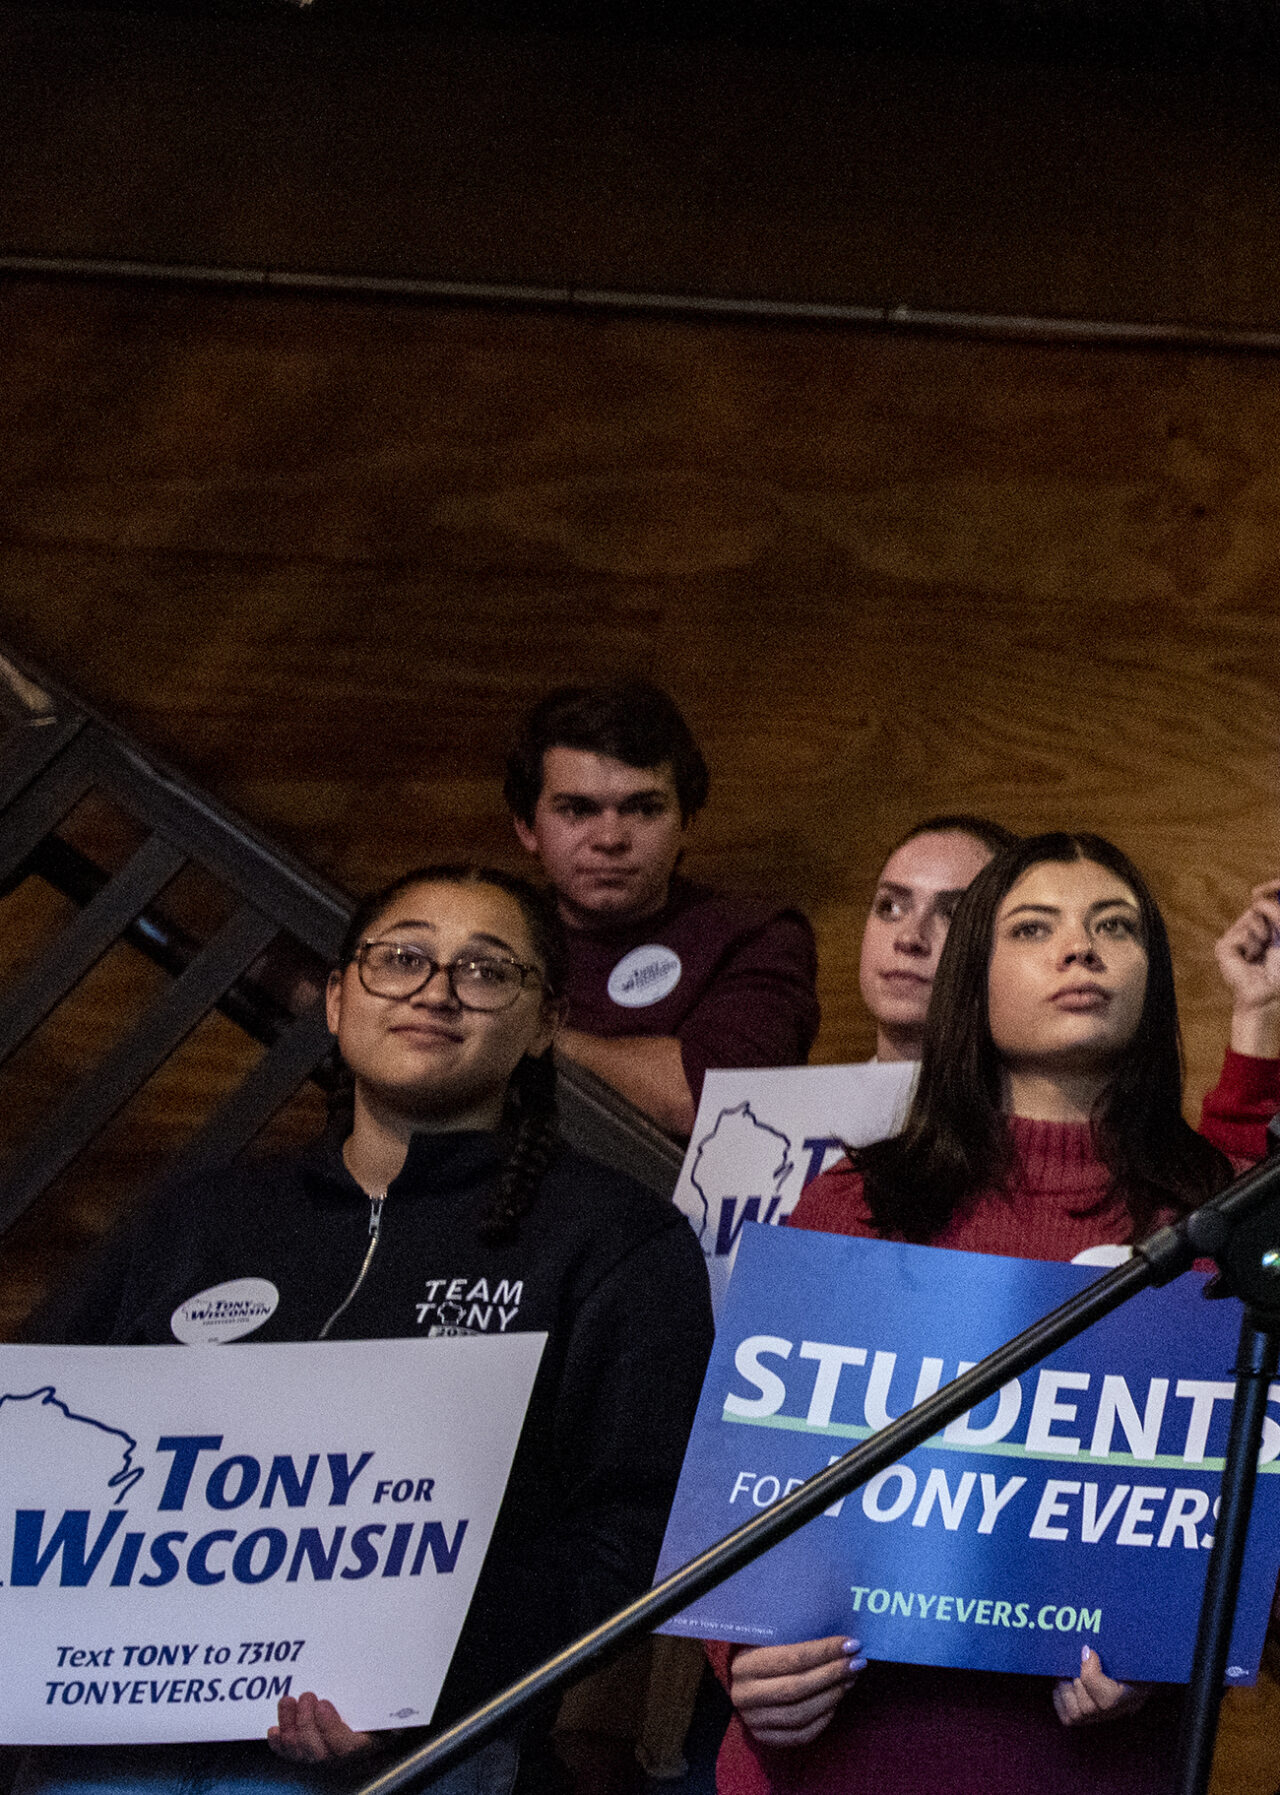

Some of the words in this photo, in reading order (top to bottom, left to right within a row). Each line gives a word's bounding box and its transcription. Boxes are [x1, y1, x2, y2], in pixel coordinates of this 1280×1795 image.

[425, 1277, 523, 1304] TEAM
[156, 1435, 375, 1512] TONY
[373, 1478, 435, 1505] FOR
[824, 1455, 1027, 1534] ONY
[10, 1510, 469, 1588] WISCONSIN
[850, 1585, 1102, 1635] TONYEVERS.COM
[56, 1646, 115, 1667] Text
[122, 1644, 199, 1667] TONY
[204, 1643, 231, 1665] to
[236, 1640, 305, 1665] 73107
[45, 1675, 293, 1705] TONYEVERS.COM
